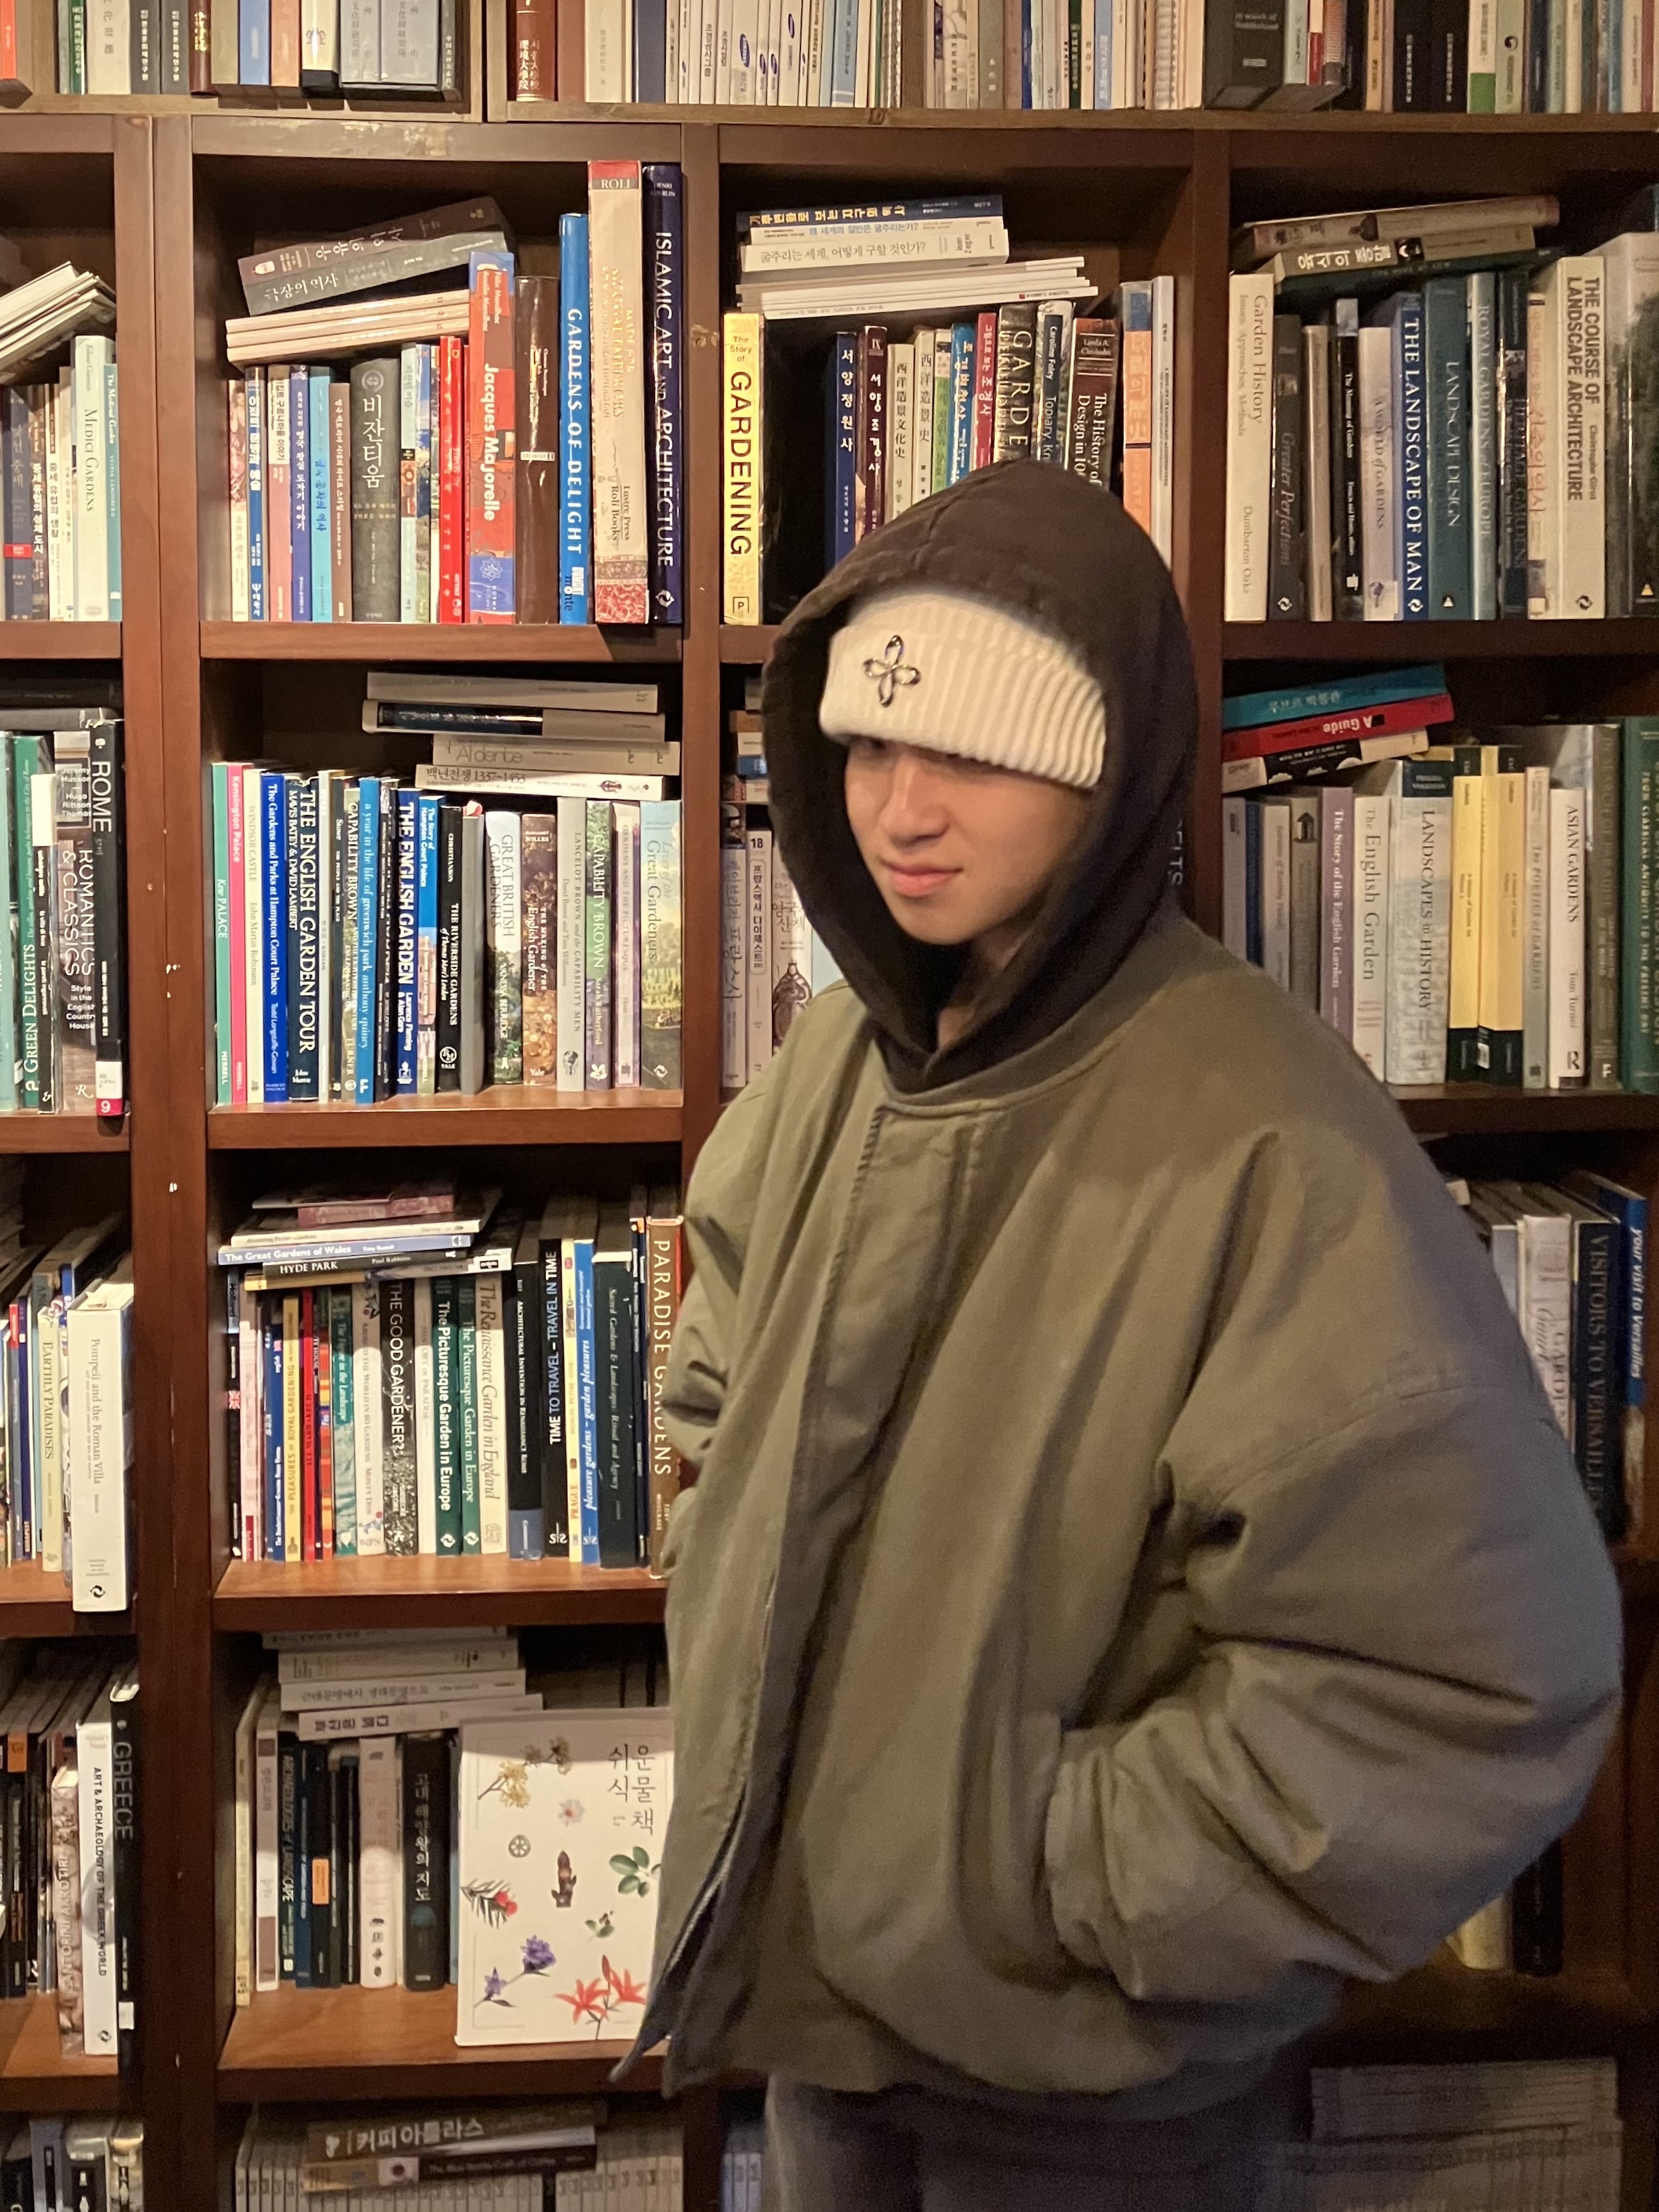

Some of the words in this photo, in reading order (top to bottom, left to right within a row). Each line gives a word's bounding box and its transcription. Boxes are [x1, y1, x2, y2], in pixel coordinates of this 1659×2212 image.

[601, 179, 630, 189] ROLI
[656, 233, 673, 319] ISLAMIC
[1584, 279, 1600, 308] THE
[1253, 295, 1268, 356] Garden
[1404, 319, 1420, 363] THE
[1567, 277, 1582, 375] LANDSCAPE
[1584, 313, 1600, 379] COURSE
[568, 309, 583, 411] GARDENS
[656, 327, 673, 369] ART
[481, 363, 499, 432] Jacques
[657, 375, 666, 401] AND
[978, 376, 992, 415] 조경사
[1093, 394, 1108, 417] The
[1248, 363, 1266, 424] History
[1446, 362, 1460, 456] LANDSCAPE
[1584, 392, 1600, 405] OF
[84, 409, 98, 453] MEDICI
[276, 439, 285, 460] 이야기
[363, 395, 385, 489] 비잔티움
[568, 423, 583, 449] OF
[1088, 420, 1105, 469] History
[1405, 370, 1421, 500] LANDSCAPE
[1567, 381, 1584, 501] ARCHITECTURE
[481, 437, 500, 521] Majorelle
[730, 371, 752, 554] GARDENING
[1280, 433, 1295, 485] Greater
[85, 457, 99, 511] GARDENS
[657, 407, 673, 566] ARCHITECTURE
[1448, 465, 1461, 527] DESIGN
[568, 461, 583, 554] DELIGHT
[1406, 506, 1421, 534] OF
[1407, 542, 1422, 591] MAN
[92, 760, 112, 832] ROME
[269, 784, 277, 802] The
[300, 790, 315, 827] THE
[269, 803, 278, 840] Gardens
[348, 802, 358, 872] CAPABILITY
[399, 802, 414, 837] THE
[1333, 810, 1344, 830] The
[1366, 809, 1376, 829] The
[1566, 805, 1579, 849] ASIAN
[63, 850, 79, 864] &
[269, 842, 278, 859] and
[501, 834, 513, 881] GREAT
[647, 840, 661, 881] Great
[1330, 834, 1344, 864] Story
[1361, 834, 1381, 903] English
[1420, 810, 1435, 918] LANDSCAPES
[269, 861, 279, 884] Parks
[269, 886, 278, 895] at
[300, 834, 315, 911] ENGLISH
[399, 841, 414, 910] ENGLISH
[1333, 867, 1344, 879] of
[1333, 882, 1344, 898] the
[1566, 854, 1579, 922] GARDENS
[269, 898, 279, 937] Hampton
[348, 876, 357, 920] BROWN
[503, 885, 515, 936] BRITISH
[63, 872, 80, 976] CLASSICS
[527, 907, 538, 945] English
[647, 885, 661, 960] Gardeners
[1331, 902, 1343, 943] English
[270, 939, 279, 965] Court
[300, 917, 316, 996] GARDEN
[399, 913, 414, 984] GARDEN
[722, 926, 742, 1002] 프랑스사
[1332, 947, 1343, 988] Garden
[1362, 913, 1380, 980] Garden
[22, 944, 37, 1018] DELIGHTS
[270, 967, 280, 995] Palace
[528, 947, 539, 991] Gardener
[1418, 940, 1432, 1012] HISTORY
[1568, 971, 1578, 991] Tom
[23, 1022, 38, 1072] GREEN
[299, 1002, 316, 1053] TOUR
[225, 1253, 243, 1262] The
[245, 1251, 272, 1261] Great
[273, 1248, 315, 1260] Gardens
[316, 1246, 323, 1256] of
[324, 1246, 351, 1254] Wales
[1630, 1227, 1644, 1262] your
[280, 1264, 309, 1274] HYDE
[311, 1262, 338, 1271] PARK
[546, 1252, 559, 1280] TIME
[1632, 1265, 1644, 1294] visit
[389, 1282, 403, 1310] THE
[480, 1286, 497, 1308] The
[547, 1282, 559, 1295] IN
[1631, 1297, 1644, 1312] to
[437, 1302, 450, 1326] The
[547, 1298, 561, 1340] TRAVEL
[390, 1314, 403, 1361] GOOD
[480, 1310, 498, 1384] Renaissance
[1630, 1315, 1644, 1378] Versailles
[42, 1342, 54, 1394] EARTHLY
[89, 1338, 102, 1380] Pompeii
[437, 1328, 452, 1402] Picturesque
[549, 1354, 561, 1394] TRAVEL
[91, 1384, 103, 1402] and
[91, 1404, 103, 1422] the
[391, 1364, 405, 1450] GARDENER?
[483, 1386, 499, 1433] Garden
[549, 1398, 561, 1414] TO
[43, 1397, 55, 1459] PARADISES
[92, 1424, 103, 1460] Roman
[439, 1404, 452, 1448] Garden
[483, 1436, 499, 1449] in
[549, 1416, 562, 1445] TIME
[93, 1462, 103, 1484] Villa
[439, 1452, 452, 1464] in
[483, 1450, 501, 1499] England
[439, 1468, 452, 1511] Europe
[93, 1767, 102, 1786] ART
[609, 1743, 656, 1771] 쉬운
[113, 1741, 134, 1840] GREECE
[607, 1776, 657, 1805] 식물
[94, 1798, 104, 1868] ARCHAEOLOGY
[631, 1807, 654, 1835] 책
[97, 1942, 107, 1976] WORLD
